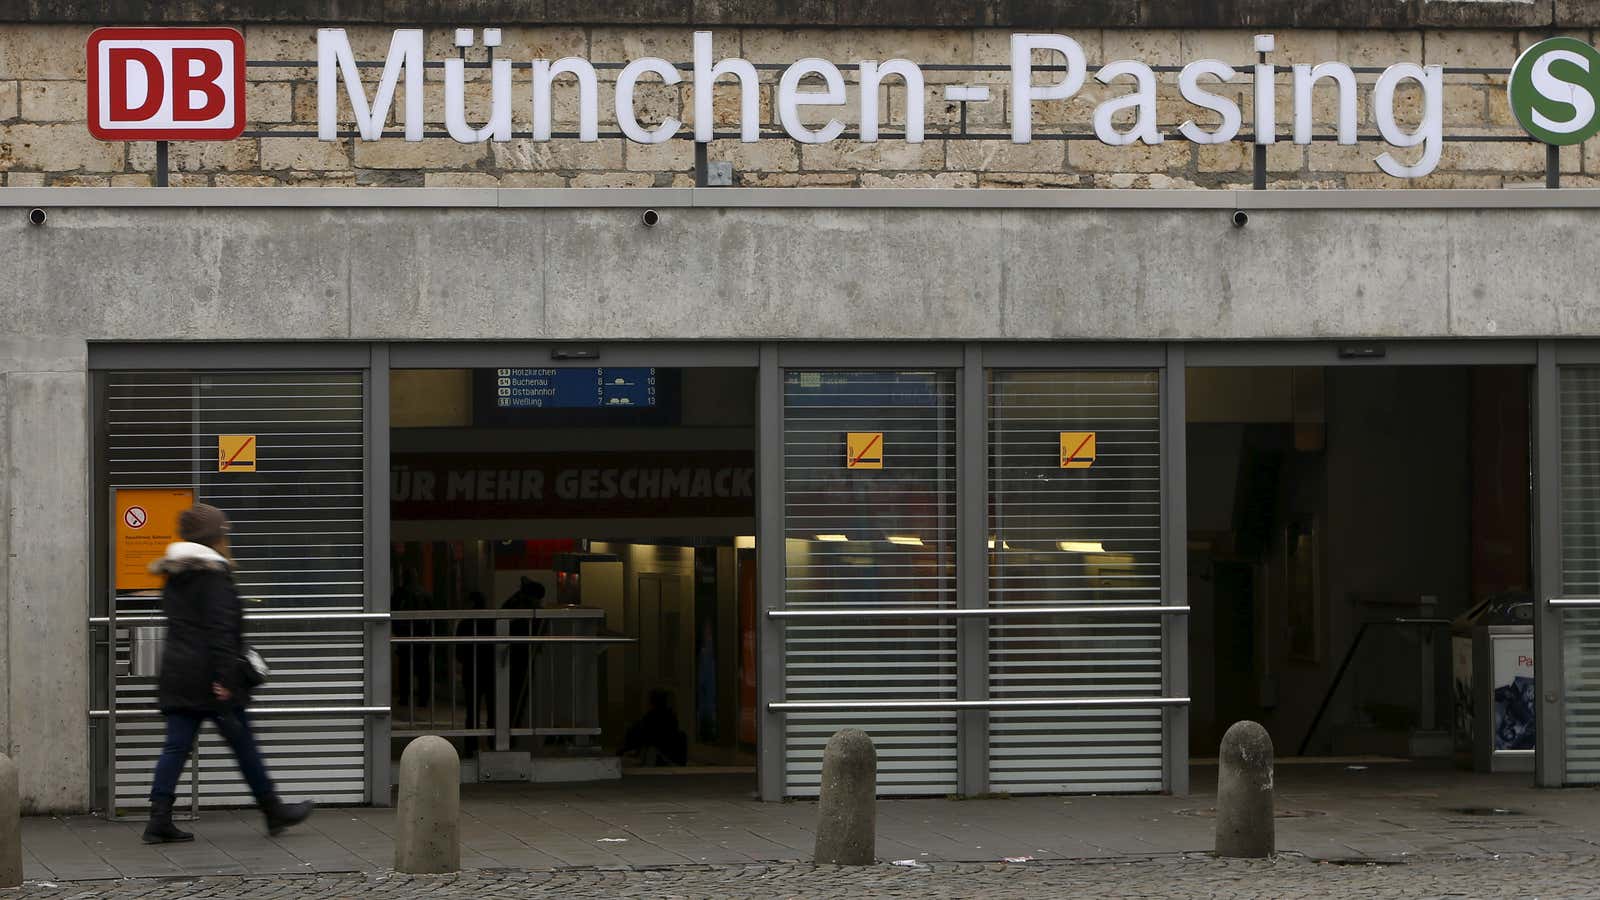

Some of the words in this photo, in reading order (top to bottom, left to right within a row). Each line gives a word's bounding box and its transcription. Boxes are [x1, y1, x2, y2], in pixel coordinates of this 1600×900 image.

[108, 46, 227, 123] DB
[1530, 49, 1596, 134] S
[317, 28, 1443, 178] München-Pasing
[512, 377, 548, 386] Buchenau
[647, 377, 656, 386] 10
[512, 387, 556, 396] Ostbahnhof
[647, 387, 656, 396] 13
[647, 397, 656, 406] 13
[446, 468, 545, 501] MEHR
[555, 466, 753, 500] GESCHMACK
